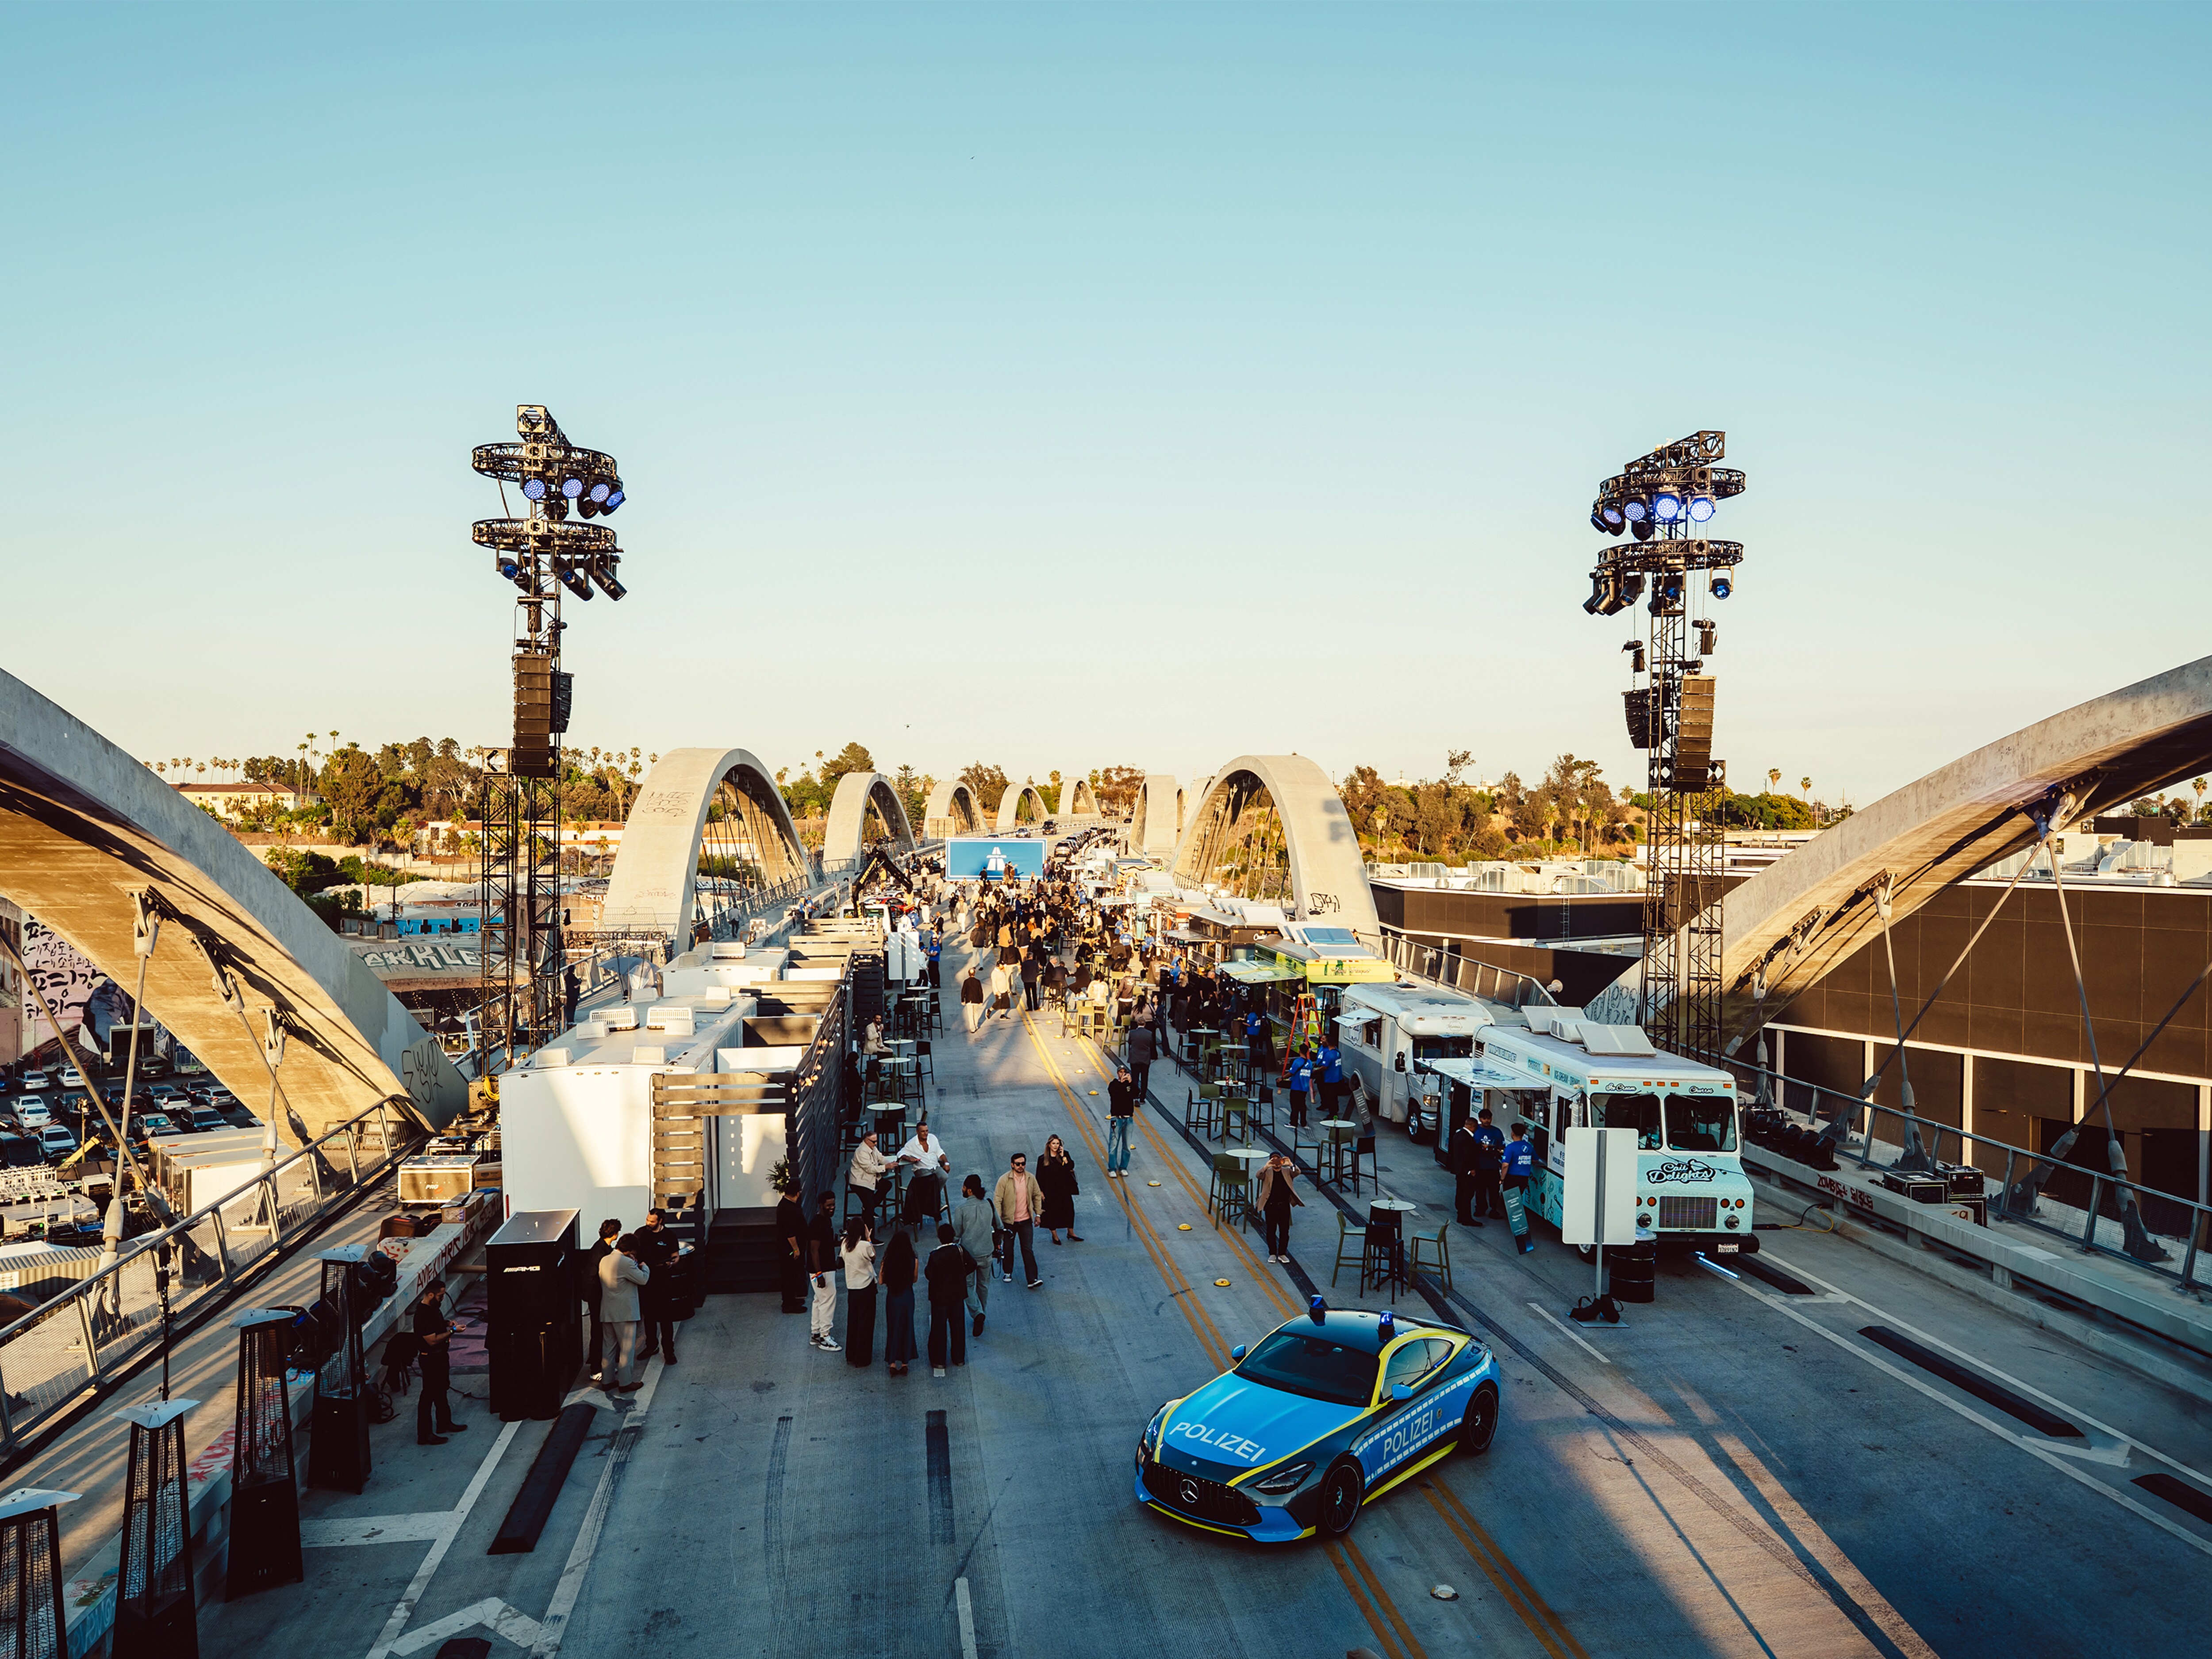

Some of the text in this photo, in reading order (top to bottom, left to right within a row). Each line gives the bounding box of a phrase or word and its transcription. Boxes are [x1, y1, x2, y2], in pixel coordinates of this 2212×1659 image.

[1647, 1170, 1713, 1183] Delights
[1169, 1422, 1266, 1462] POLIZEI
[1383, 1409, 1433, 1460] POLIZEI
